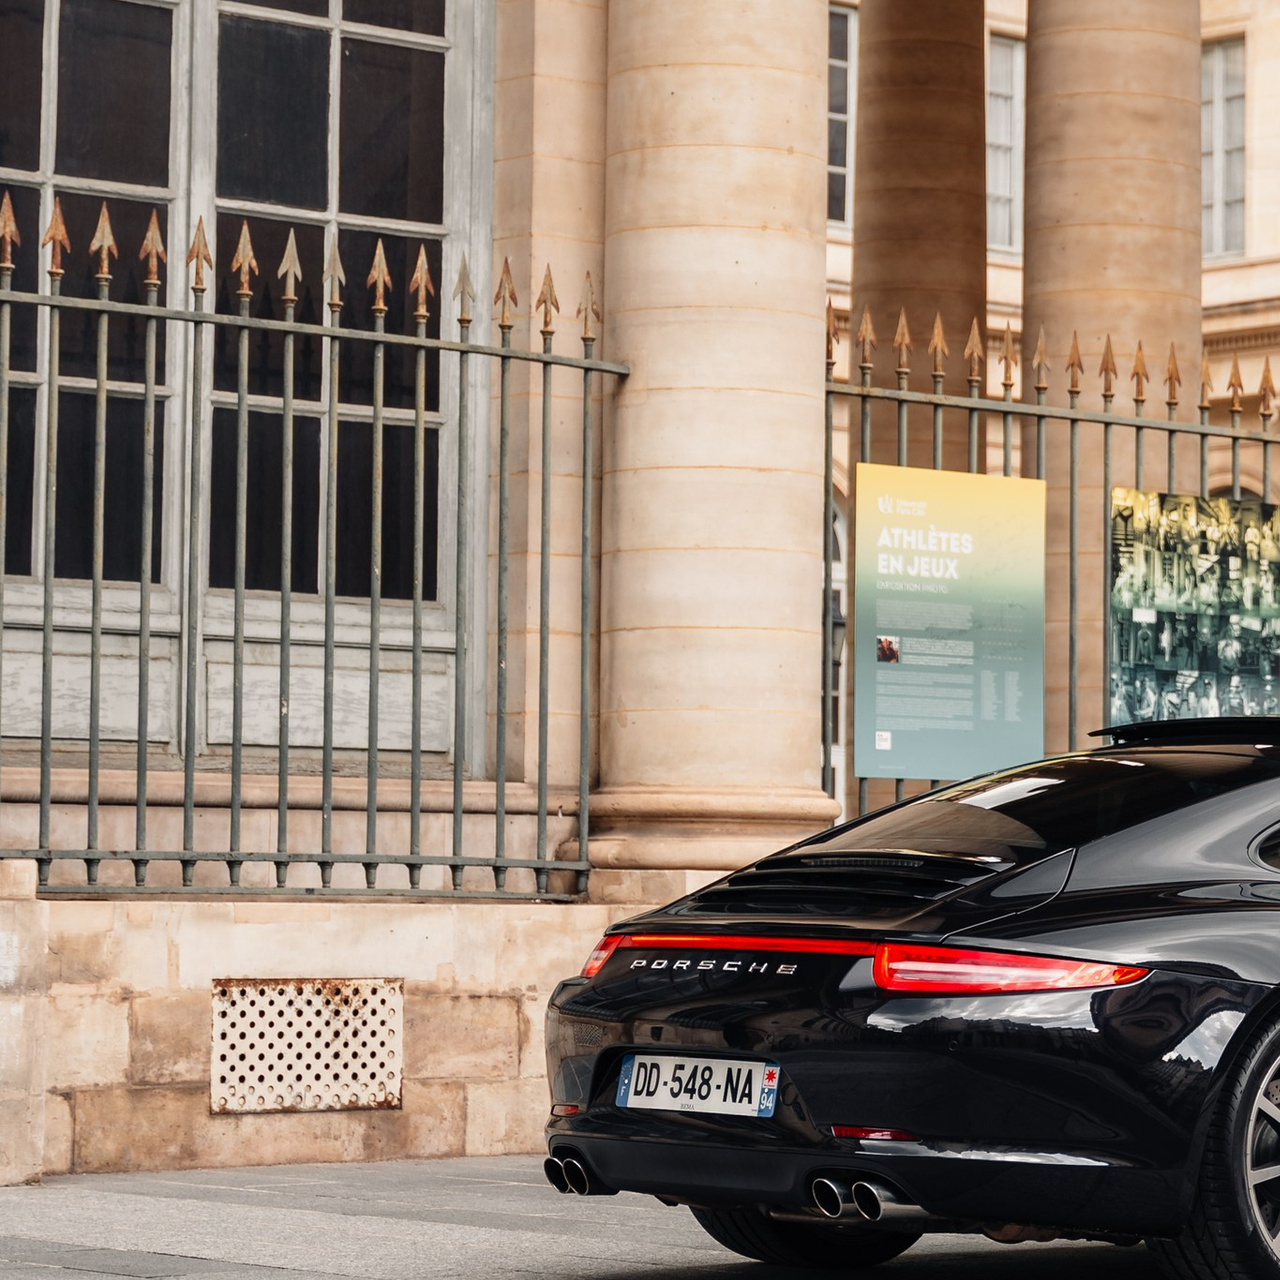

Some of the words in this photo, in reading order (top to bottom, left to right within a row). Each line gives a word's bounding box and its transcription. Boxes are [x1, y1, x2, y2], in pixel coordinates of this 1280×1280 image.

[877, 524, 974, 554] ATHLÈTES
[877, 553, 904, 575] EN
[907, 555, 960, 580] JEUX
[876, 580, 921, 592] EXPOSITION
[630, 959, 797, 975] PORSCHE
[633, 1061, 753, 1105] DD-548-NA
[760, 1093, 773, 1110] 94
